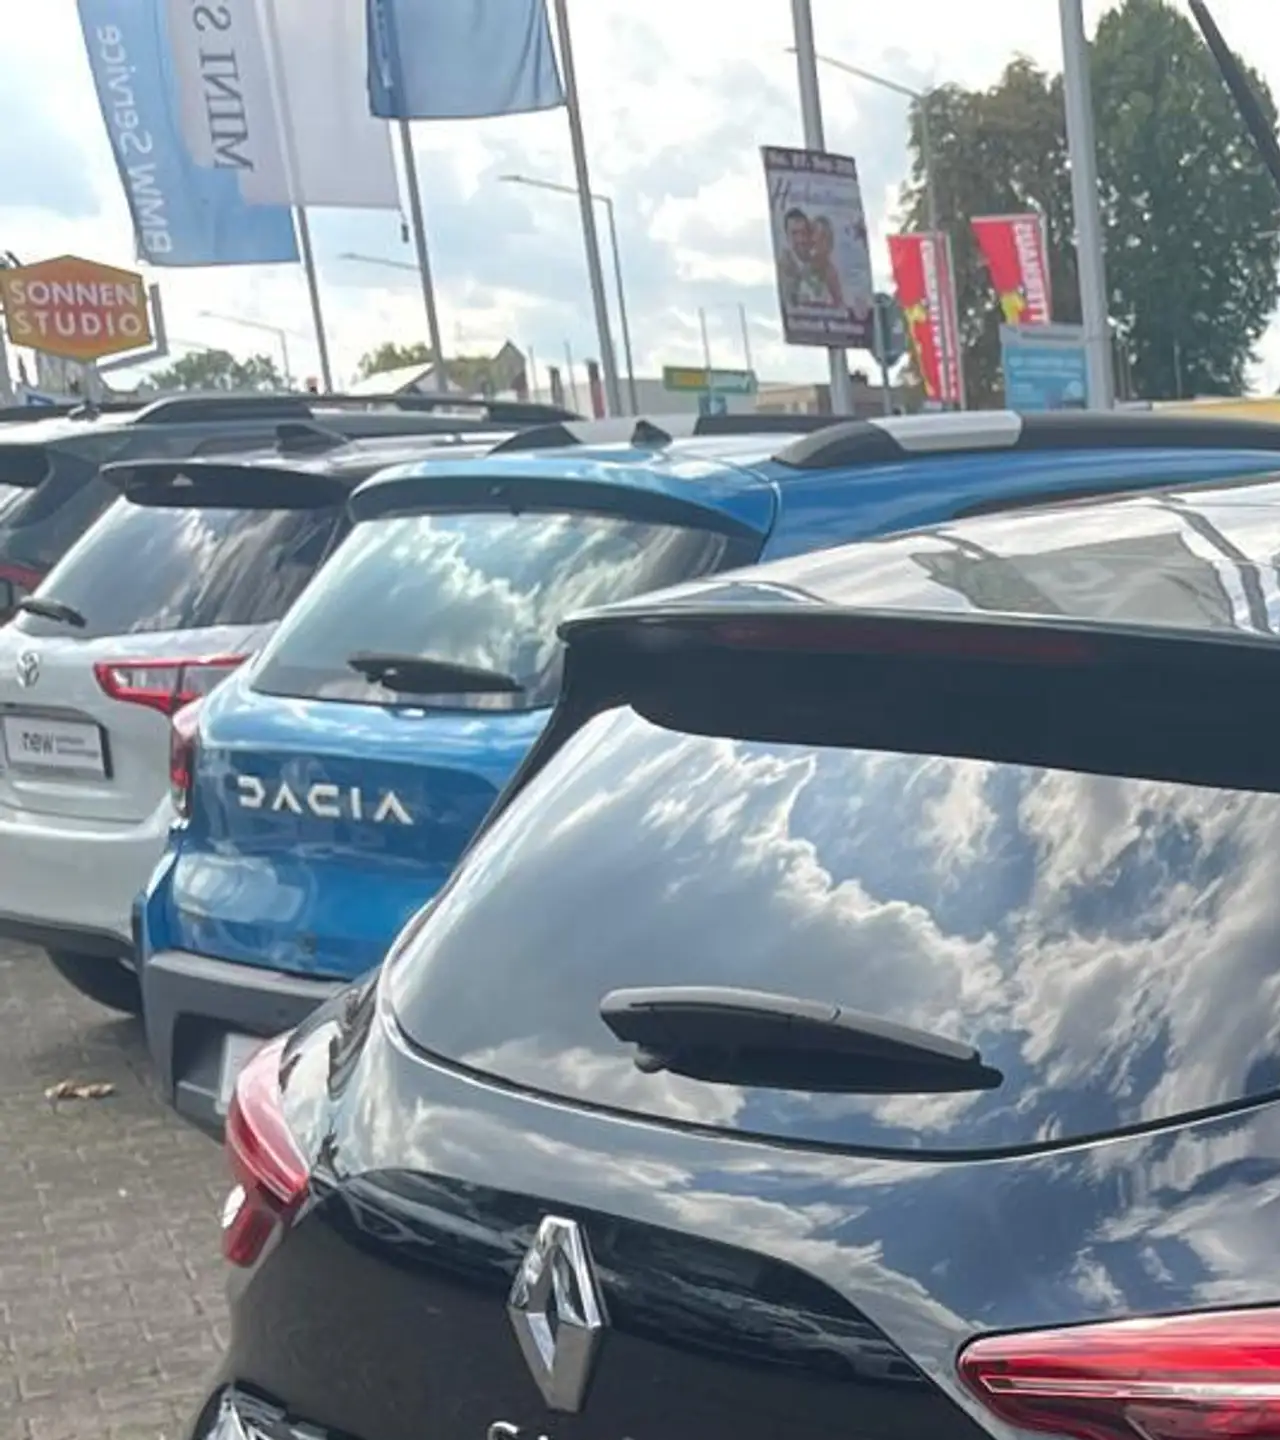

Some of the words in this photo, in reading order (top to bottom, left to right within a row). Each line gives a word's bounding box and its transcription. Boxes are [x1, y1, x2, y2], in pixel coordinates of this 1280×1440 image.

[9, 279, 138, 306] SONNEN
[13, 308, 142, 337] STUDIO
[237, 774, 415, 826] DACIA
